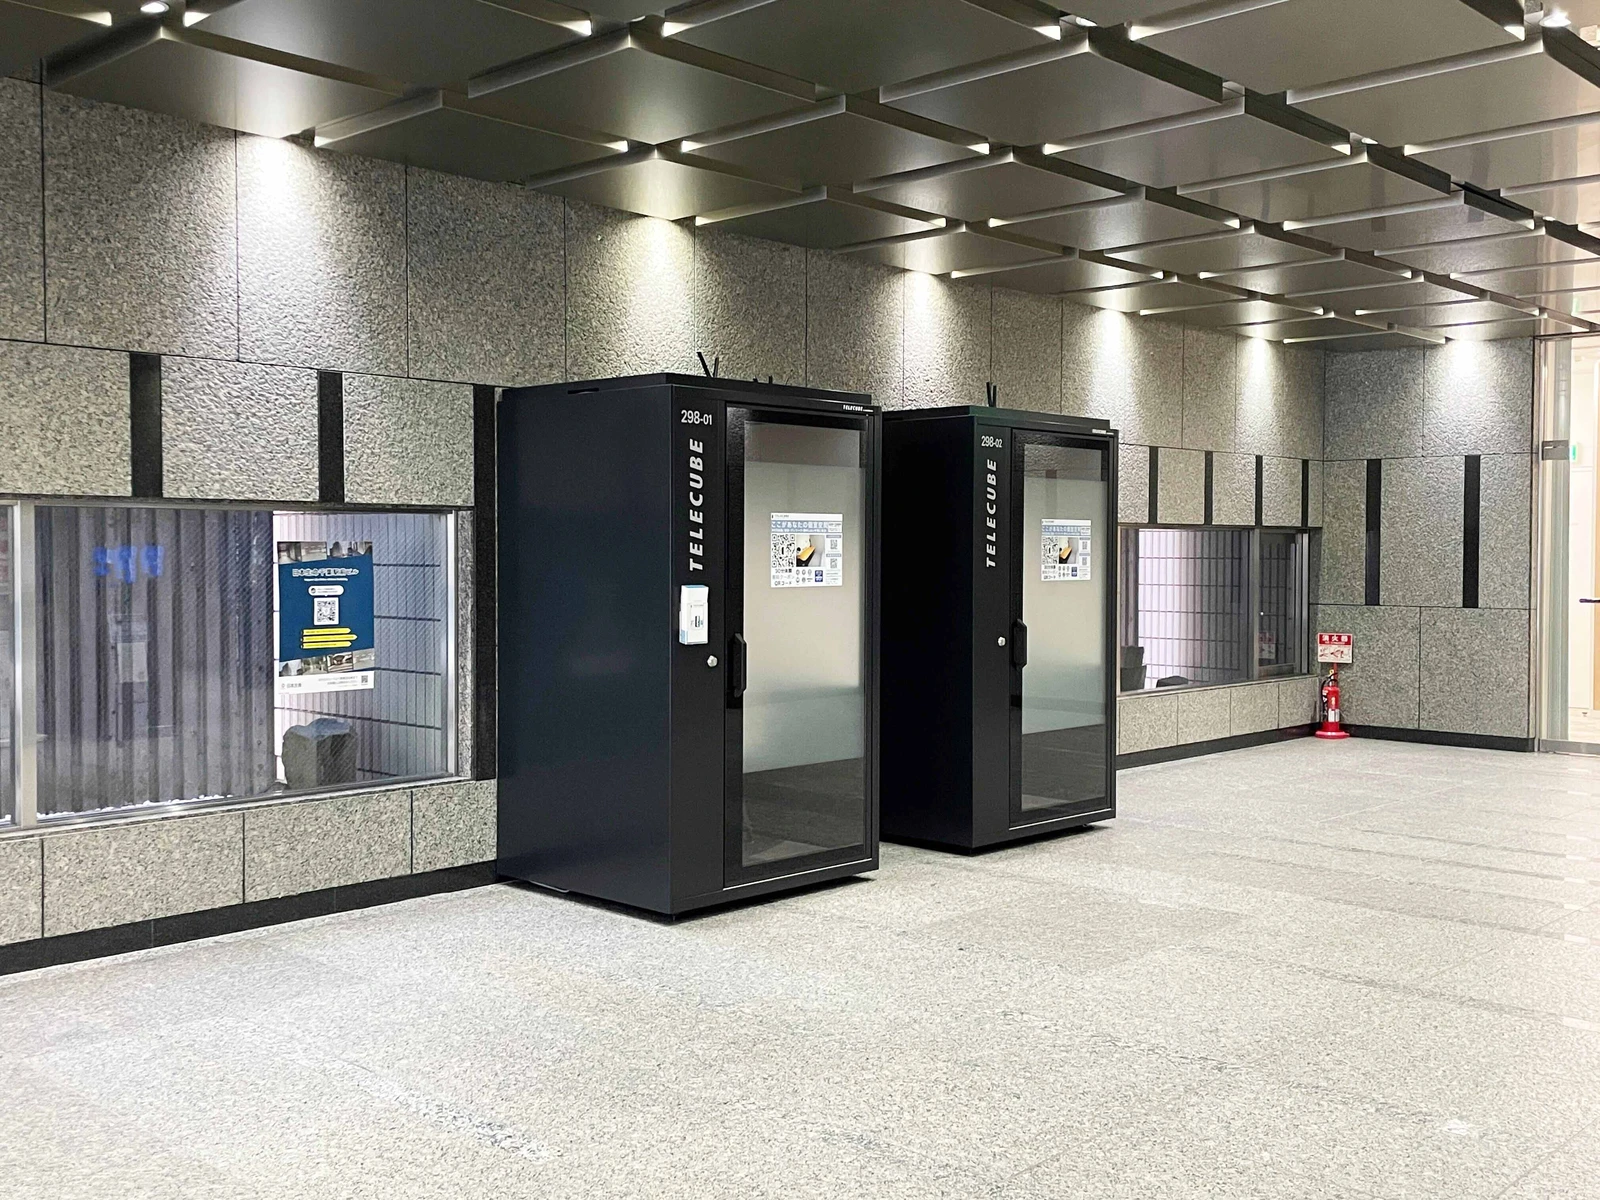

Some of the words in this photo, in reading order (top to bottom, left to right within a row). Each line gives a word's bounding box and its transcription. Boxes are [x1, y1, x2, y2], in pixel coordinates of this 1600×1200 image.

[680, 409, 713, 426] 298-01
[981, 435, 1003, 448] 298-02
[689, 438, 704, 572] TELECUBE
[986, 458, 997, 568] TELECUBE
